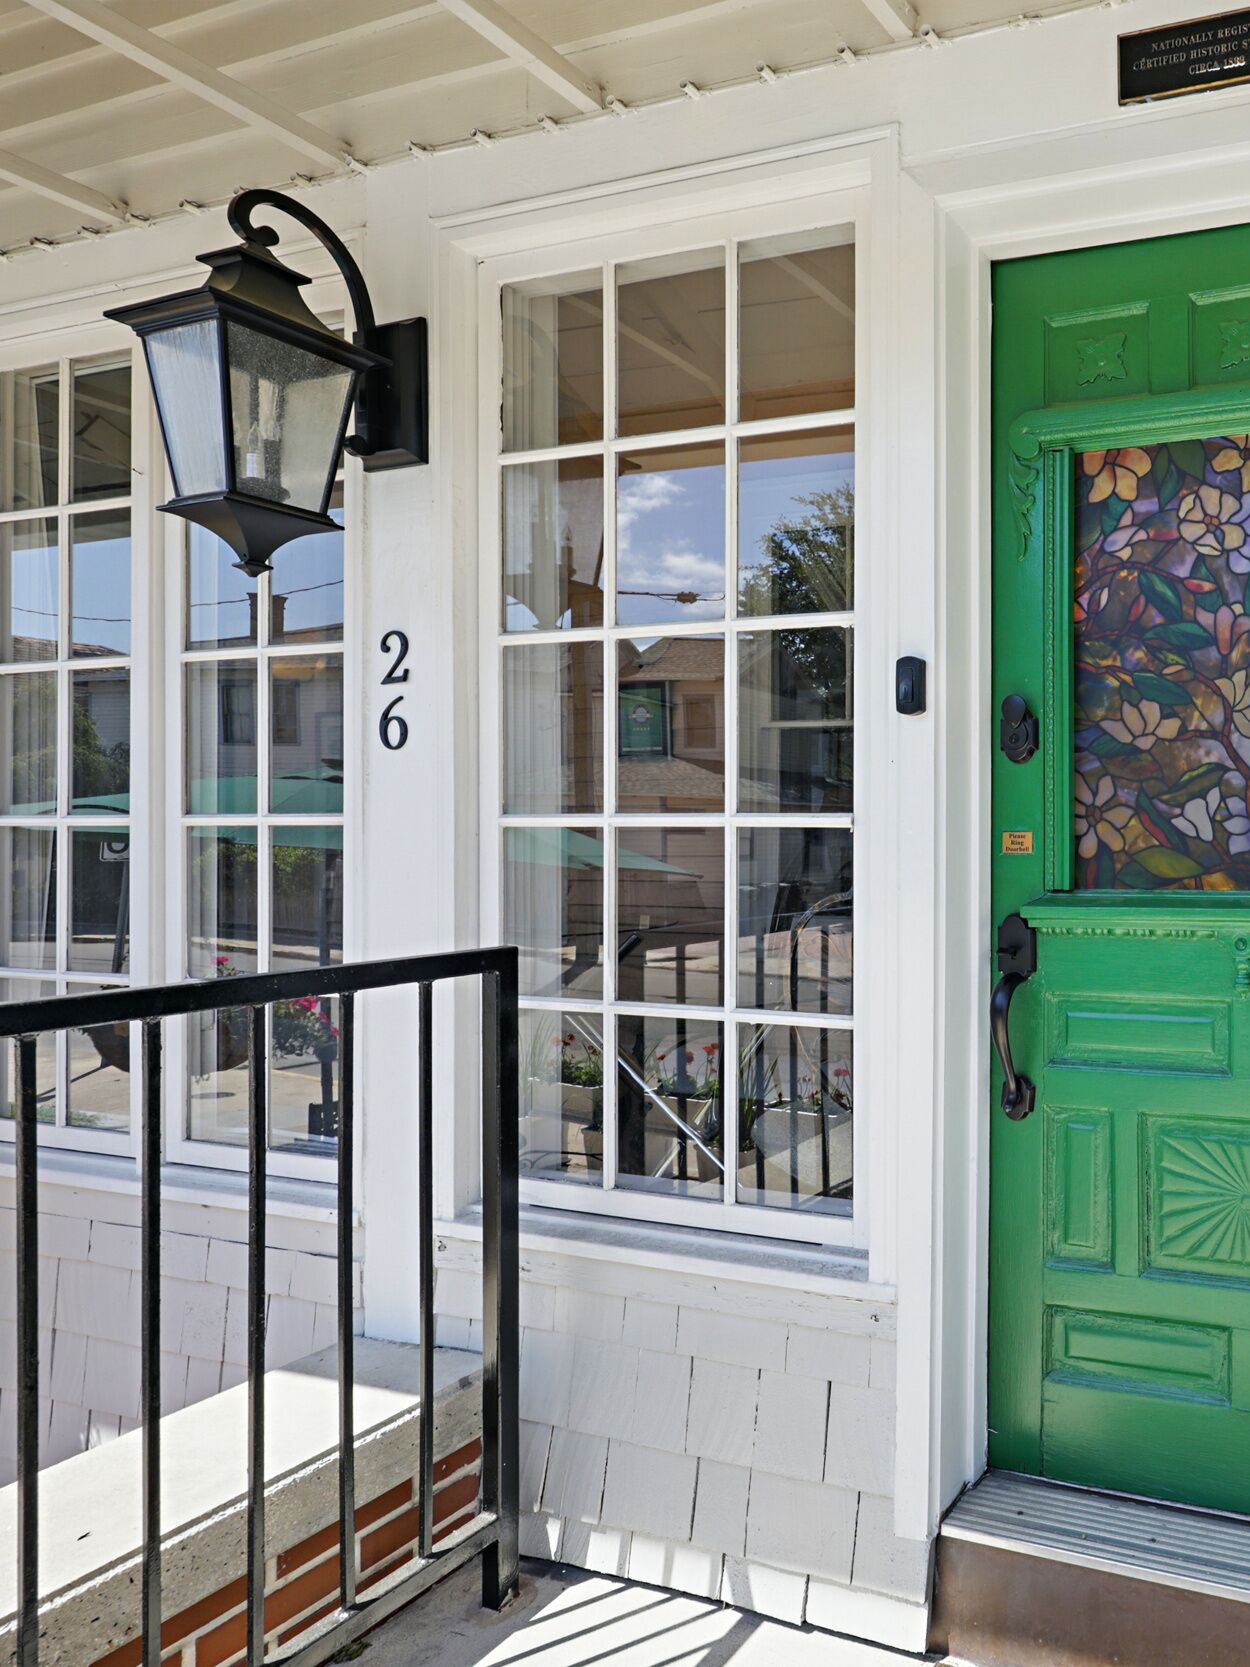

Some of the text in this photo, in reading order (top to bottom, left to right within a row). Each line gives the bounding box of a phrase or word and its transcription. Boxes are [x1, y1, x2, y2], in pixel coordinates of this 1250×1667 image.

[1151, 31, 1215, 53] NATIONALLY
[1133, 51, 1187, 71] CERTIFIED
[1190, 41, 1239, 59] HISTORIC
[1188, 59, 1220, 75] CIRCA
